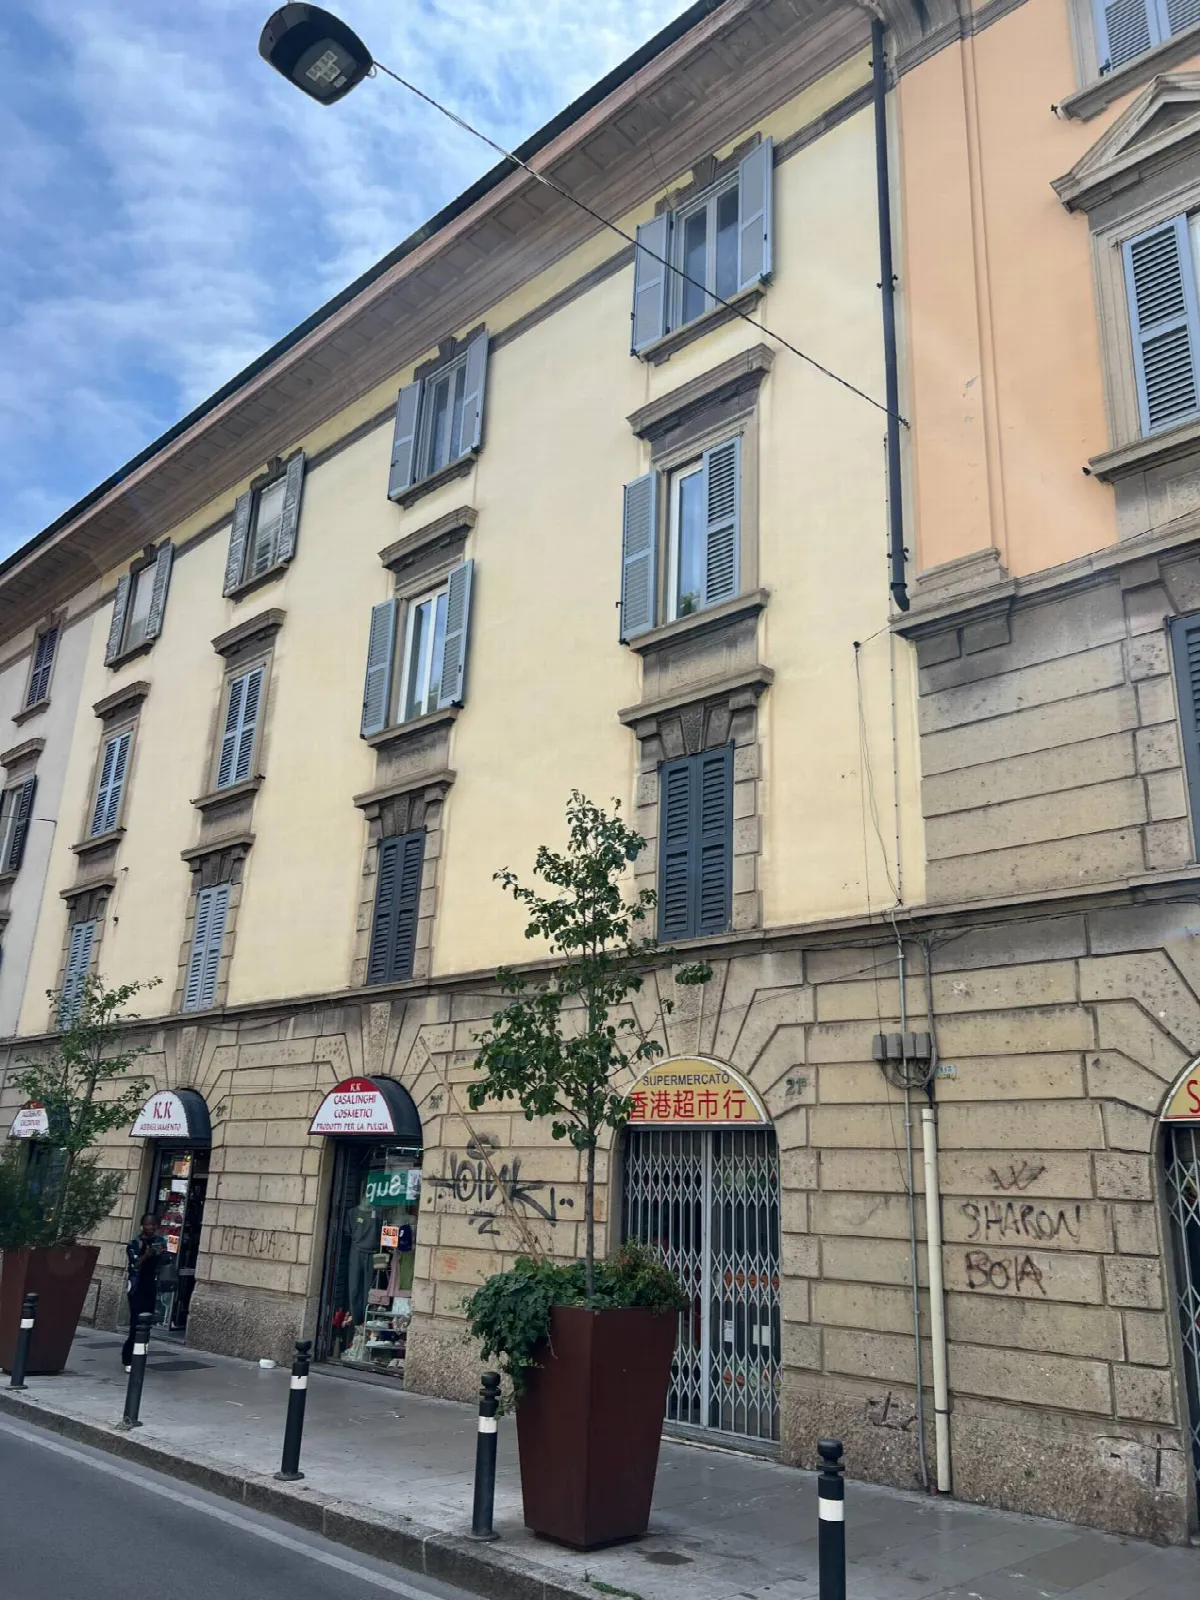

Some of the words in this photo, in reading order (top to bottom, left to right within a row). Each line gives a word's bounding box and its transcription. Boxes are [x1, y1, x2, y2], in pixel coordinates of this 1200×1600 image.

[643, 1073, 730, 1087] SUPERMERCATO
[333, 1094, 377, 1105] CASALINGHI
[629, 1089, 746, 1120] 香港超市行
[334, 1108, 373, 1119] COSMETICI
[316, 1122, 342, 1130] PRODOTTI
[344, 1122, 355, 1130] PER
[357, 1122, 364, 1130] LA
[367, 1122, 388, 1131] PULIZIA
[961, 1202, 1081, 1241] SHARON
[965, 1250, 1047, 1295] BOIA
